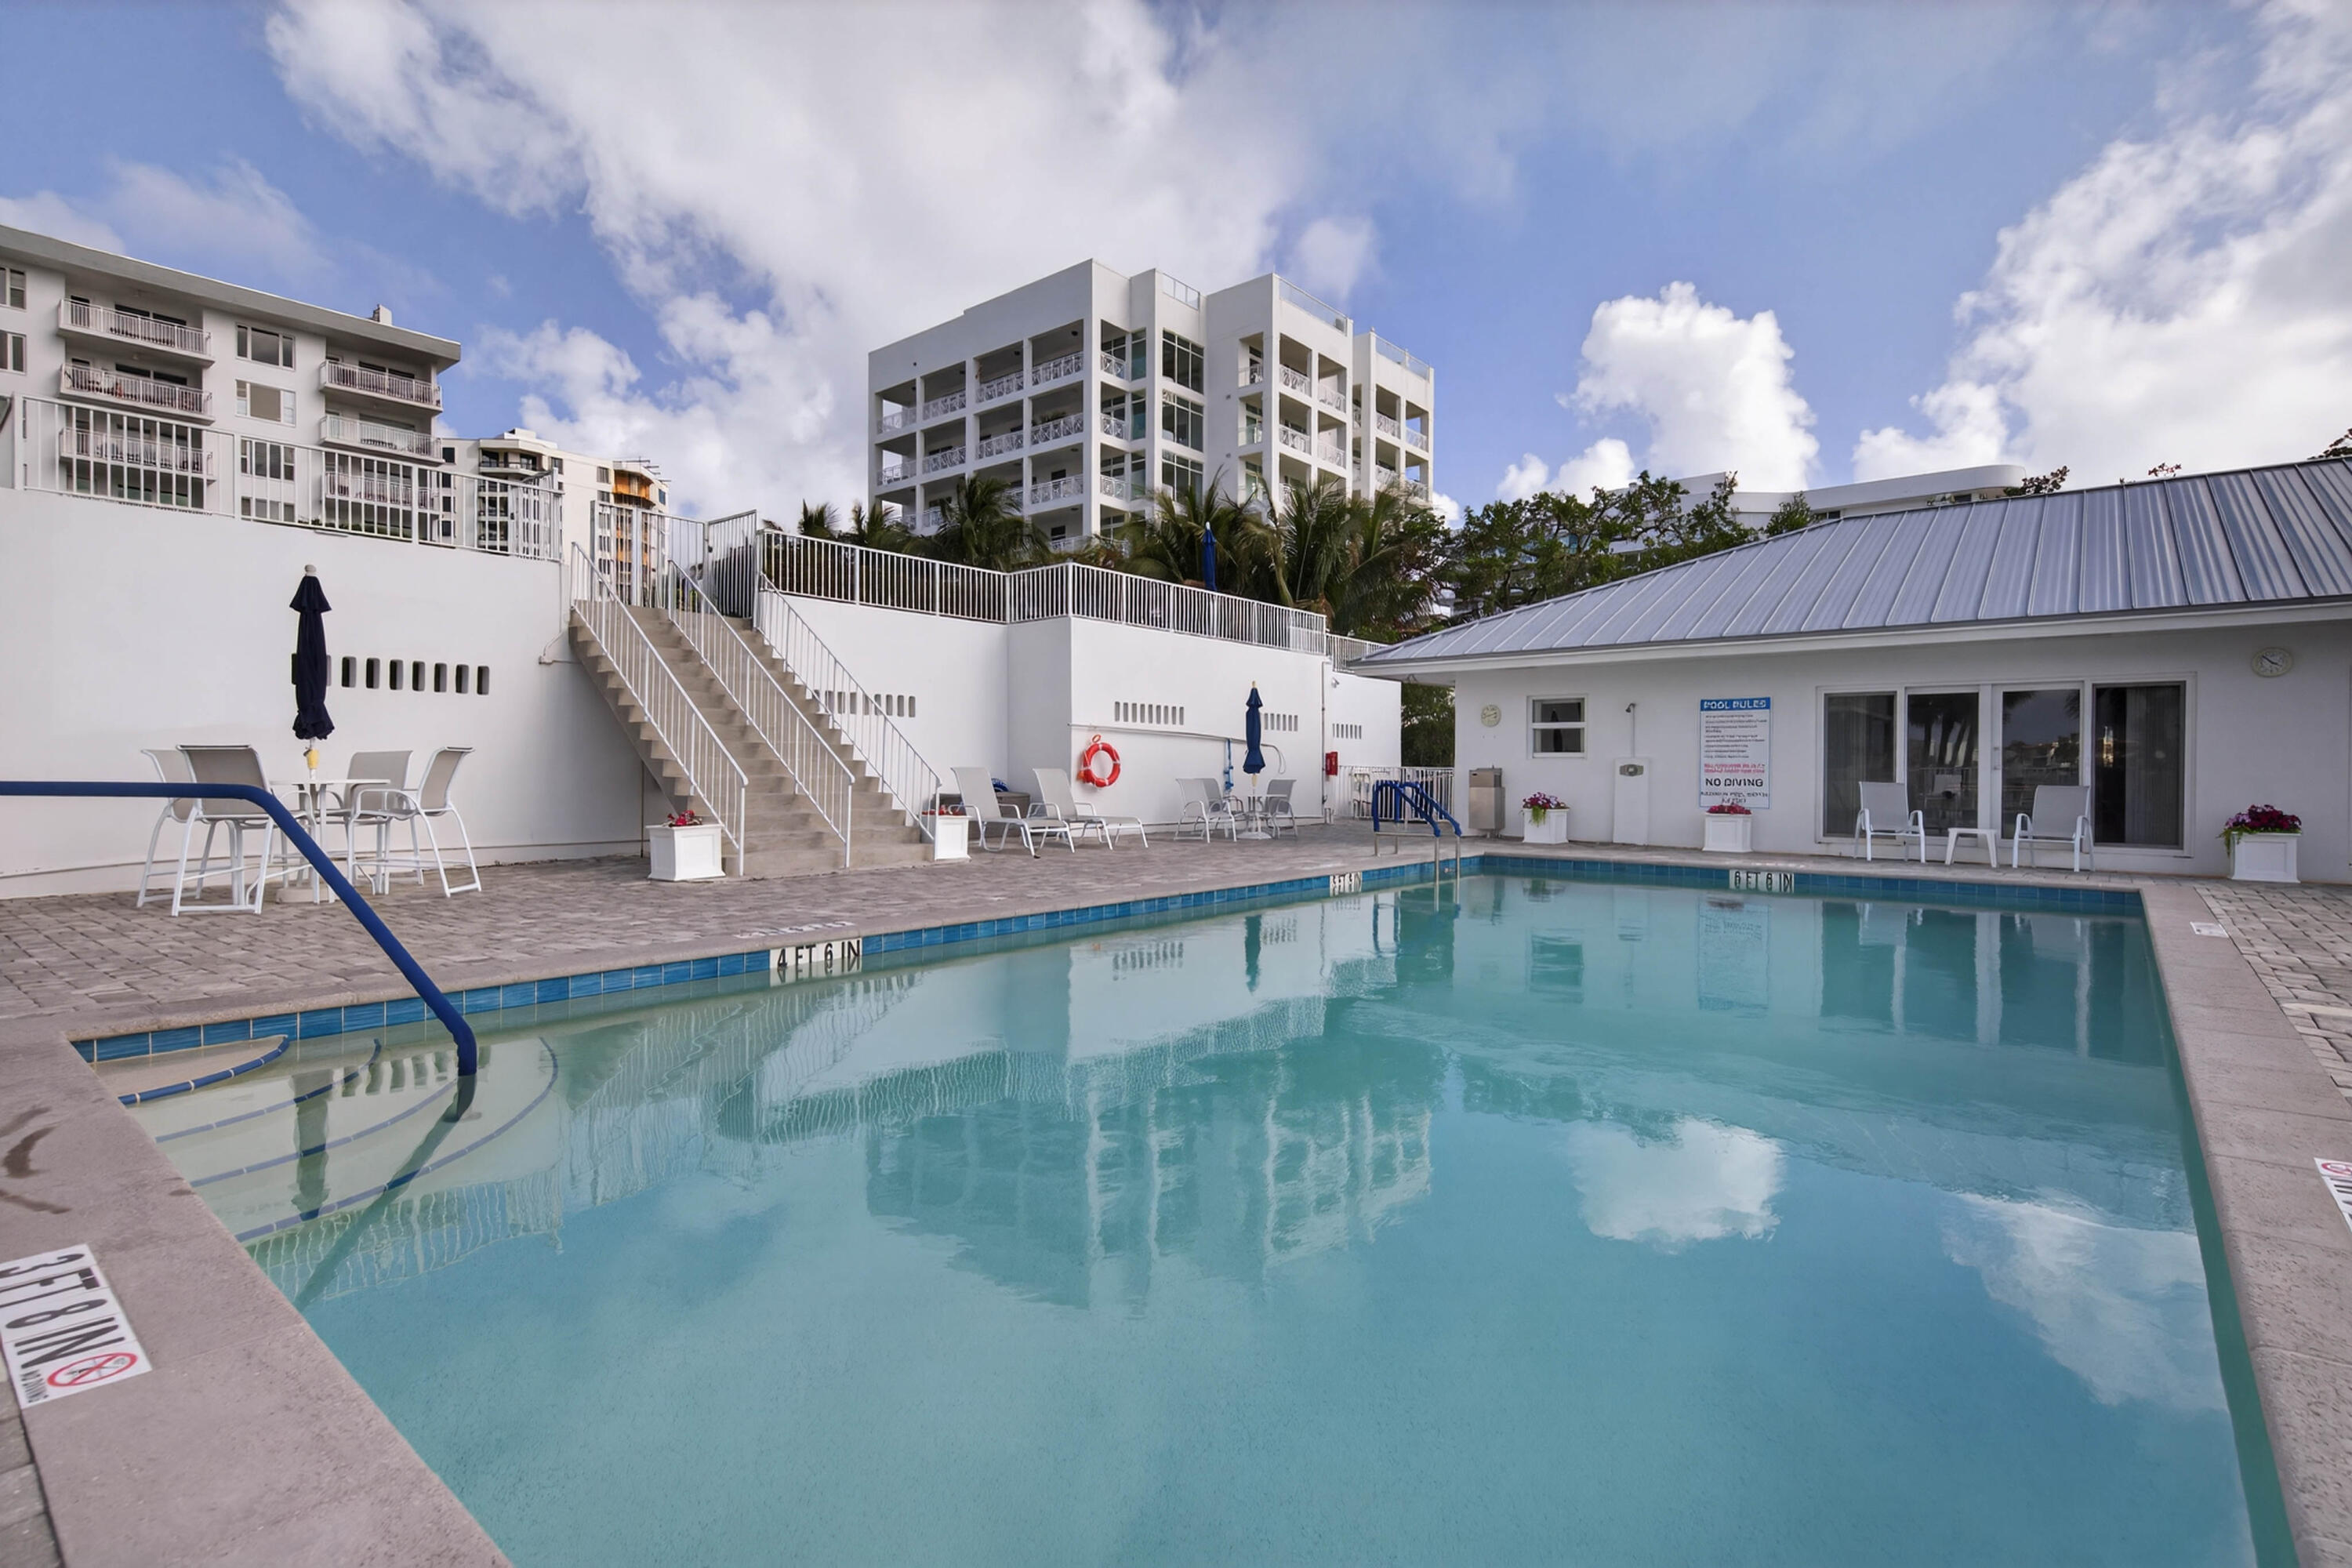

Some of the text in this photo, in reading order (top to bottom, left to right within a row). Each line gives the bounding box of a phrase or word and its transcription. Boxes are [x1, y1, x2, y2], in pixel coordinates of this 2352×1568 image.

[1704, 699, 1766, 710] POOL RULES
[1705, 778, 1763, 787] NO DIVING
[1746, 872, 1761, 884] FT
[1779, 873, 1793, 886] IN
[777, 939, 860, 967] 4 FT 6 IN
[0, 1254, 125, 1370] 3 FT 8 IN
